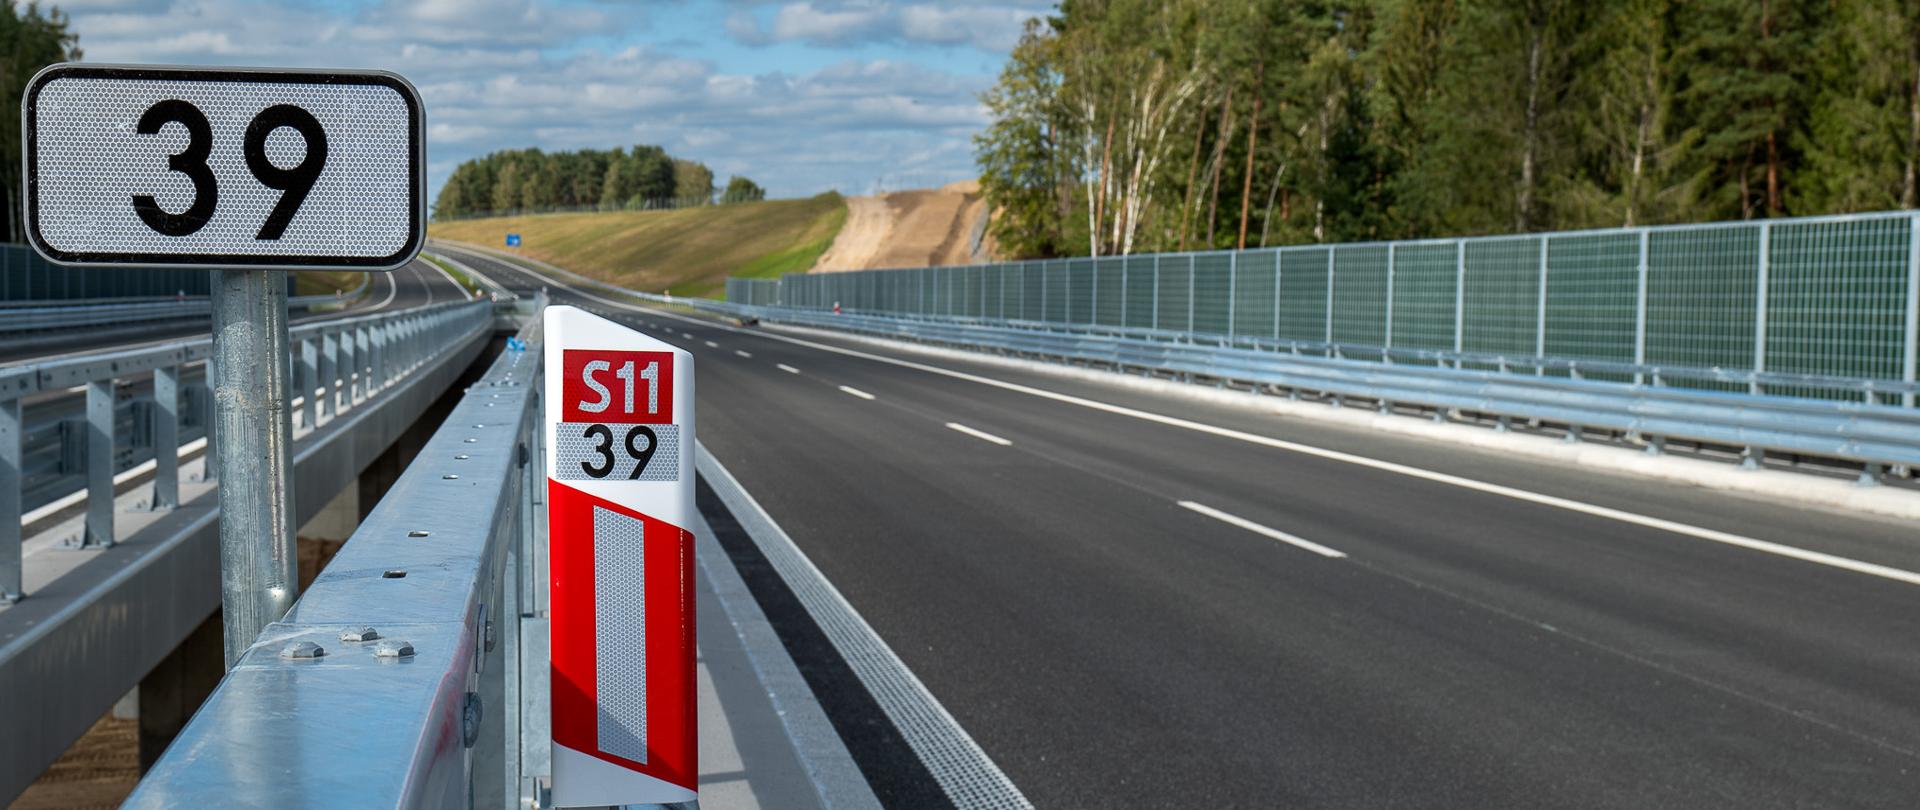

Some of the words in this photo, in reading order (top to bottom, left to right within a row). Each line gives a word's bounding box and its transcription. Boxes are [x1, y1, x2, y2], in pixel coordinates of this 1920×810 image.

[131, 98, 329, 241] 39
[577, 360, 659, 415] S11
[580, 423, 658, 480] 39
